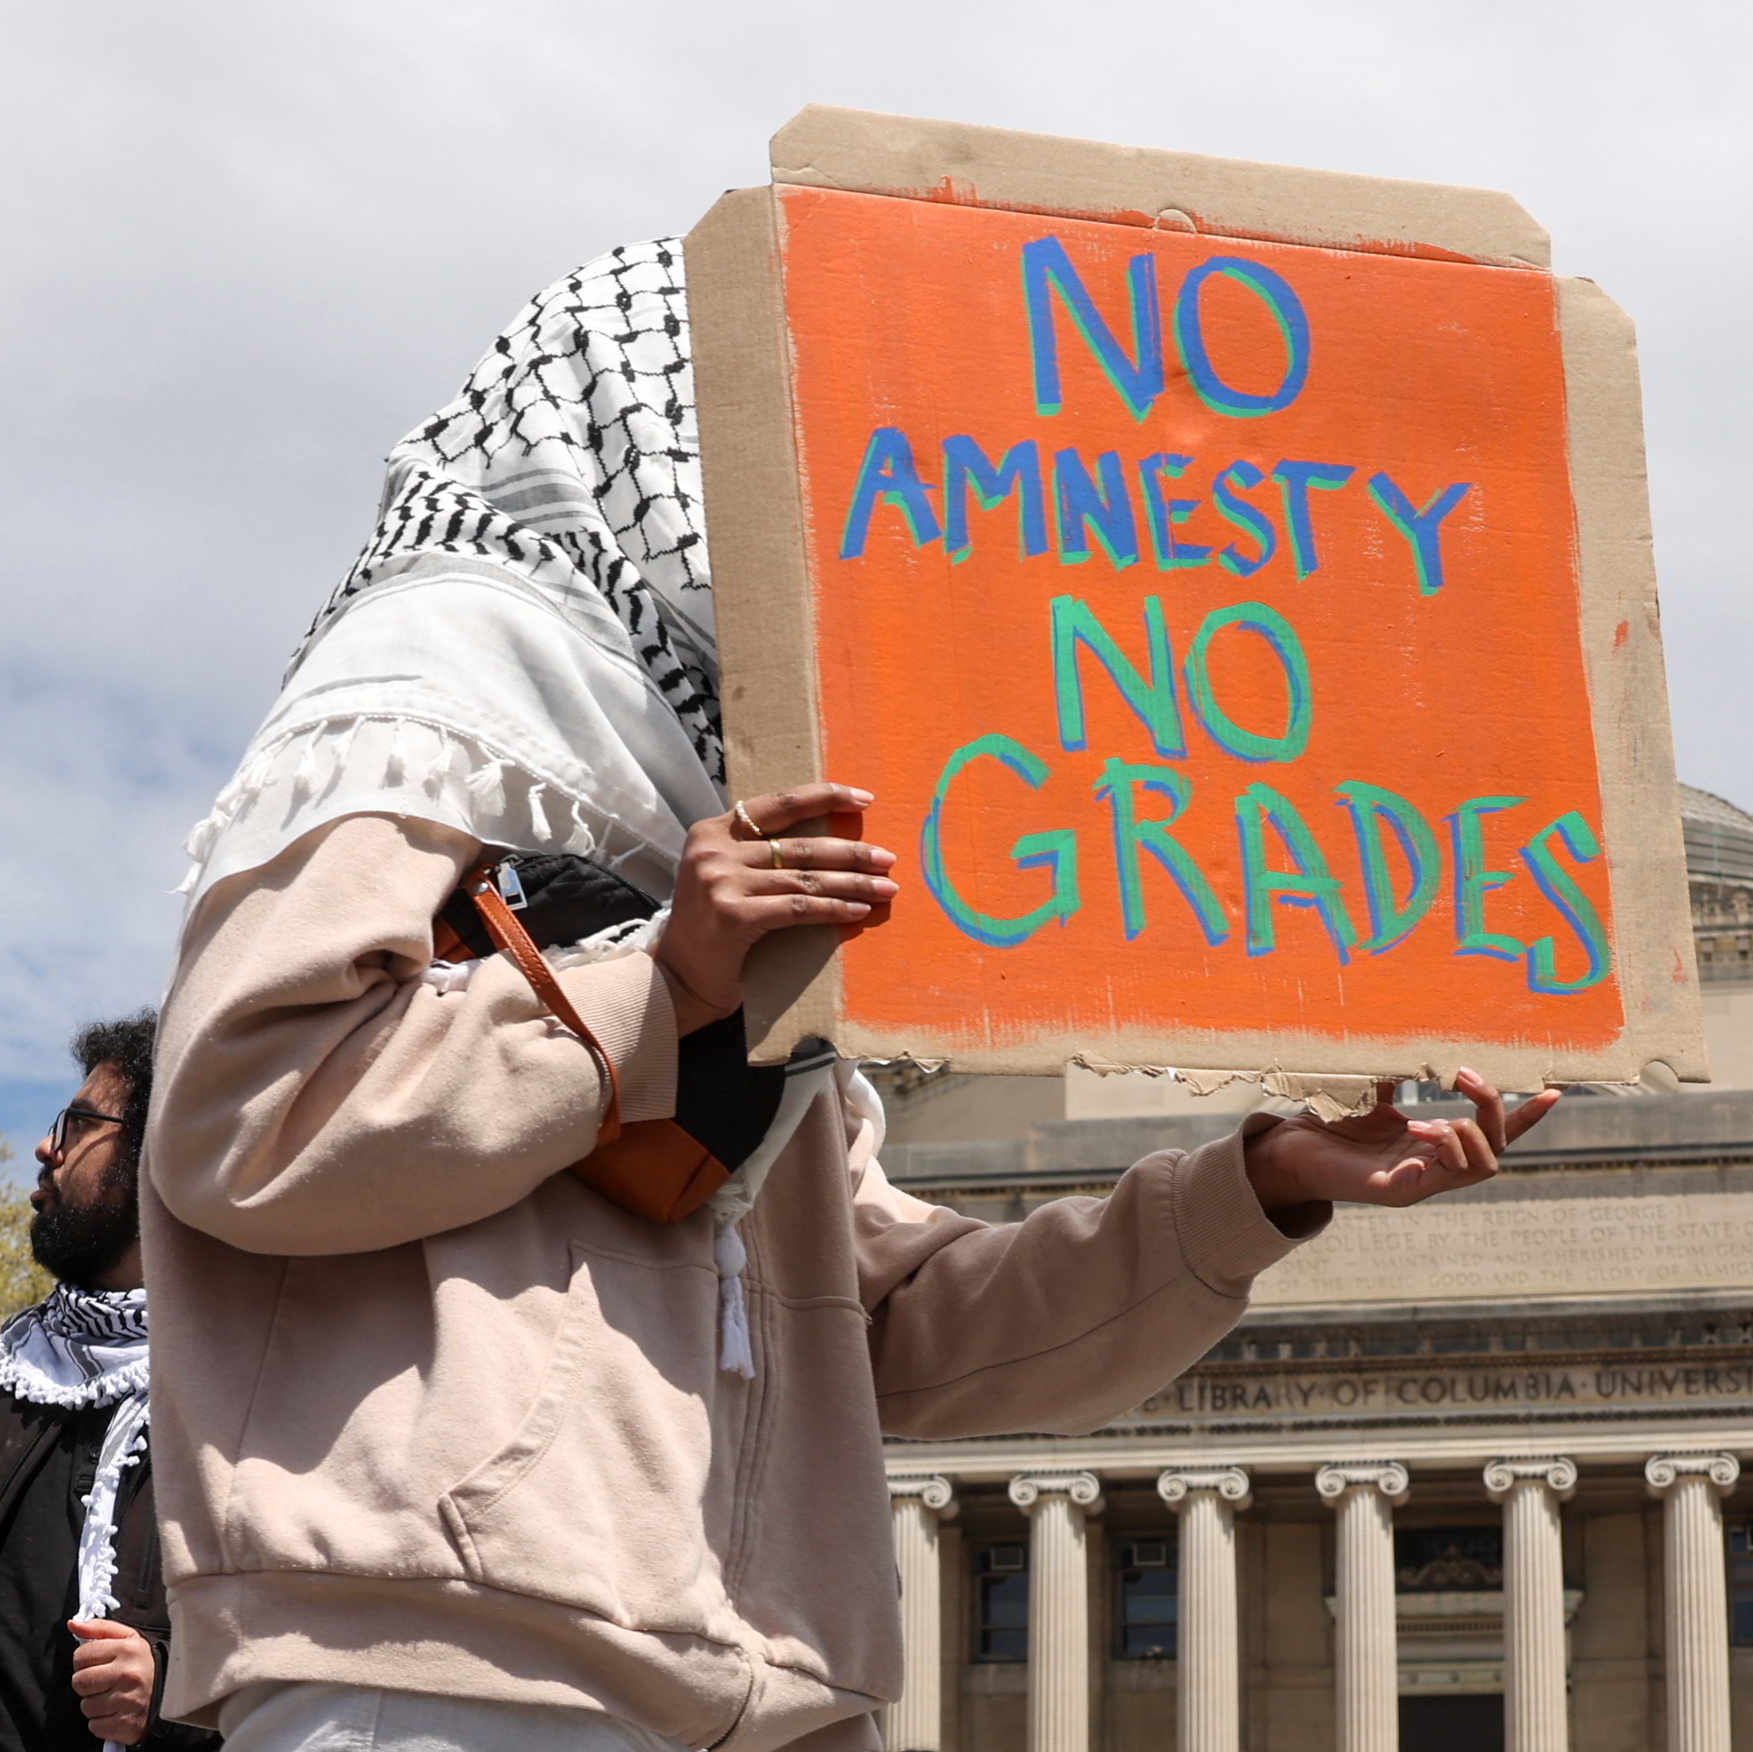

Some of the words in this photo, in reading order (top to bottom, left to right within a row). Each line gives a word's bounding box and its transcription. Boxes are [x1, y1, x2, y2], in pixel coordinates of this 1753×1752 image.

[1020, 235, 1311, 424] NO
[839, 428, 1471, 596] AMNESTY
[1052, 594, 1313, 764] NO
[920, 733, 1610, 995] GRADES
[1427, 1233, 1451, 1251] BY
[1460, 1230, 1499, 1249] THE
[1510, 1227, 1580, 1248] PEOPLE
[1589, 1225, 1618, 1244] OF
[1627, 1223, 1666, 1242] THE
[1676, 1220, 1733, 1240] STATE
[1432, 1211, 1470, 1228] THE
[1482, 1208, 1540, 1227] REIGN
[1552, 1206, 1578, 1225] OF
[1587, 1203, 1667, 1223] GEORGE
[1493, 1250, 1532, 1266] AND
[1541, 1246, 1644, 1266] CHERISHED
[1655, 1244, 1706, 1261] FROM
[1311, 1276, 1343, 1293] THE
[1354, 1273, 1415, 1291] PUBLIC
[1428, 1270, 1481, 1289] GOOD
[1493, 1269, 1531, 1286] AND
[1540, 1267, 1574, 1285] THE
[1585, 1265, 1645, 1284] GLORY
[1656, 1263, 1680, 1281] OF
[1177, 1381, 1316, 1412] LIBRARY
[1334, 1378, 1378, 1407] OF
[1397, 1371, 1576, 1405] COLUMBIA
